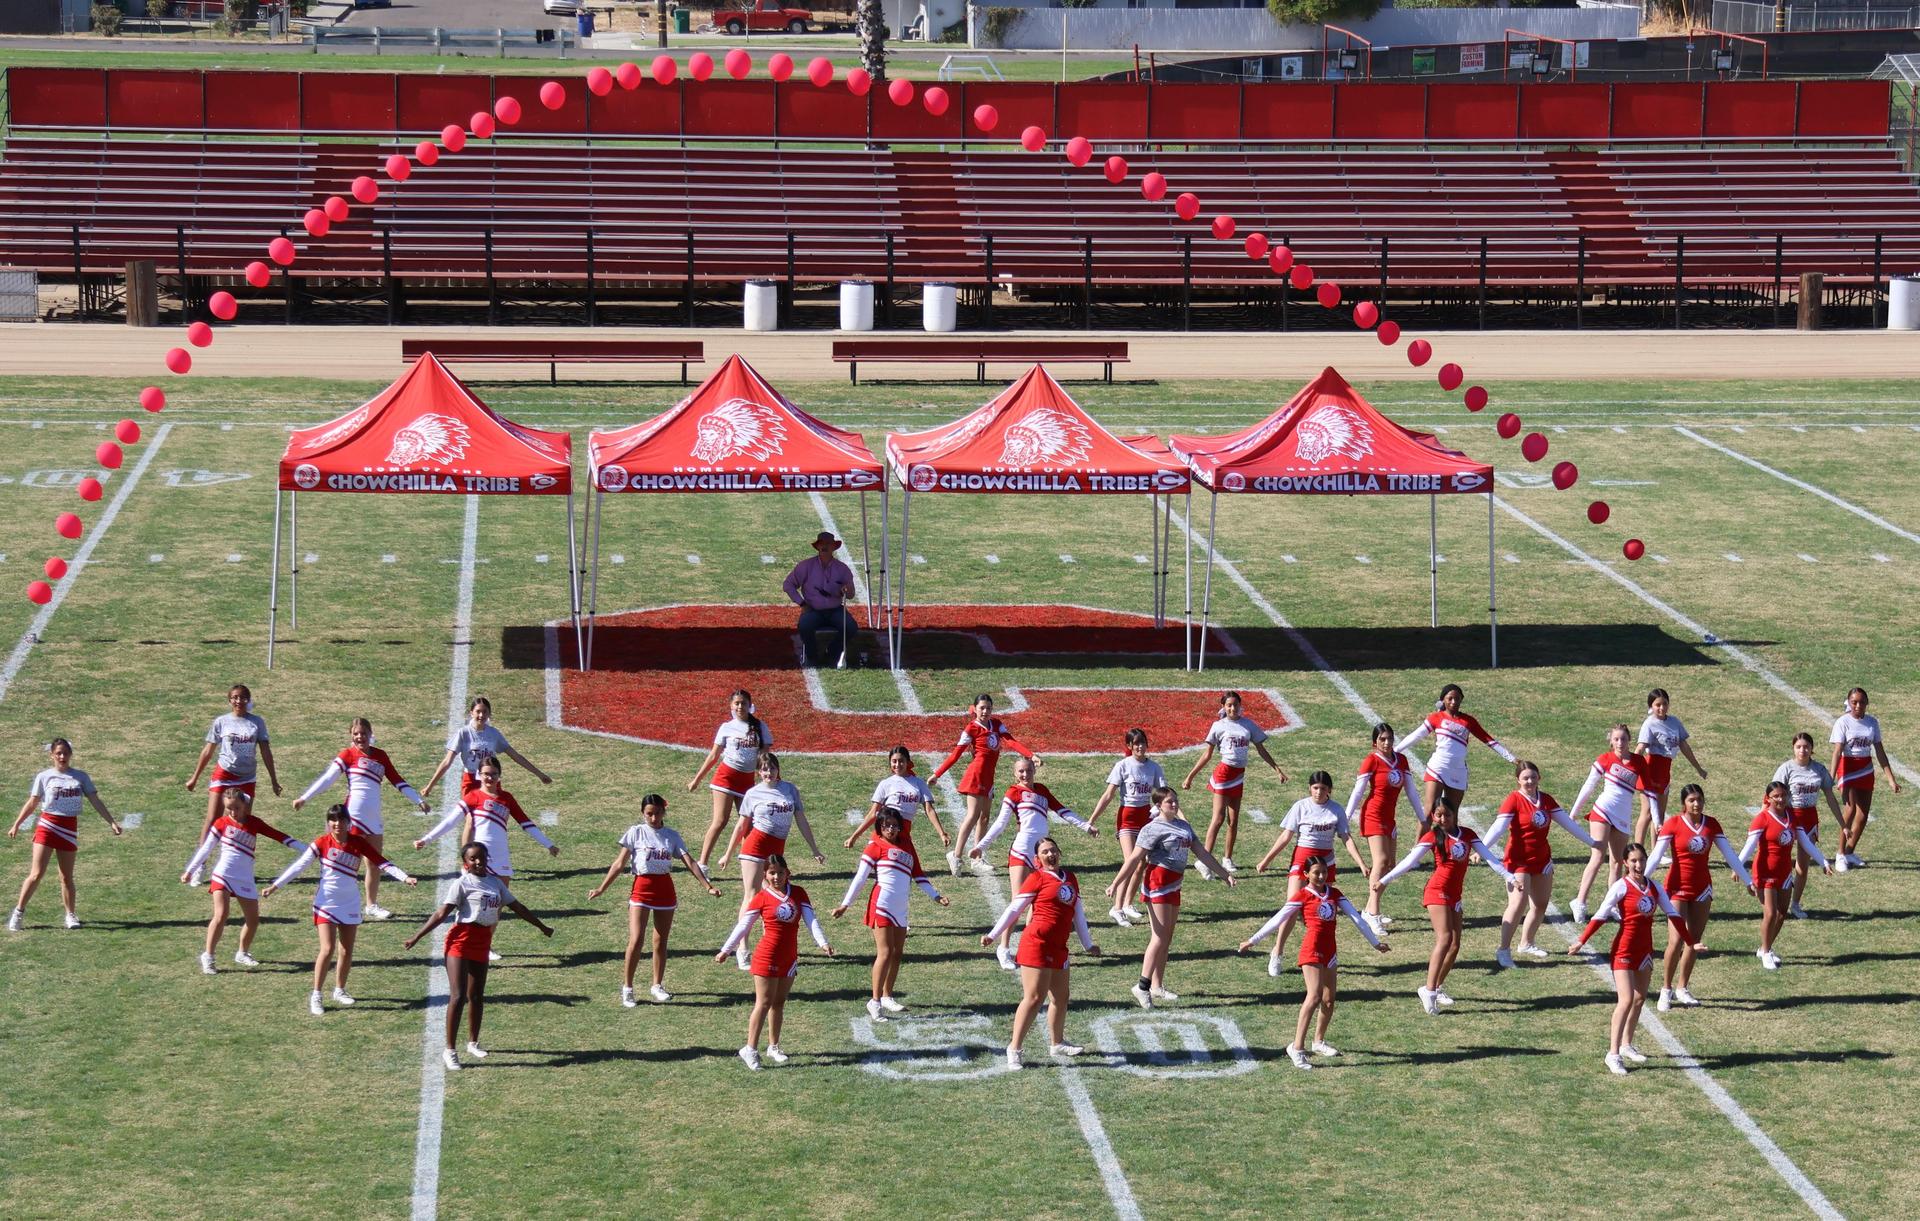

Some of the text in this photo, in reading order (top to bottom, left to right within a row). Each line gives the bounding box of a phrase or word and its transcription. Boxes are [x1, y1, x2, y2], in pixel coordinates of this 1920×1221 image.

[327, 474, 520, 492] CHOWCHILLA TRIBE
[630, 474, 843, 490] CHOWCHILLA TRIBE
[939, 474, 1150, 491] CHOWCHILLA TRIBE
[1253, 474, 1442, 492] CHOWCHILLA TRIBE
